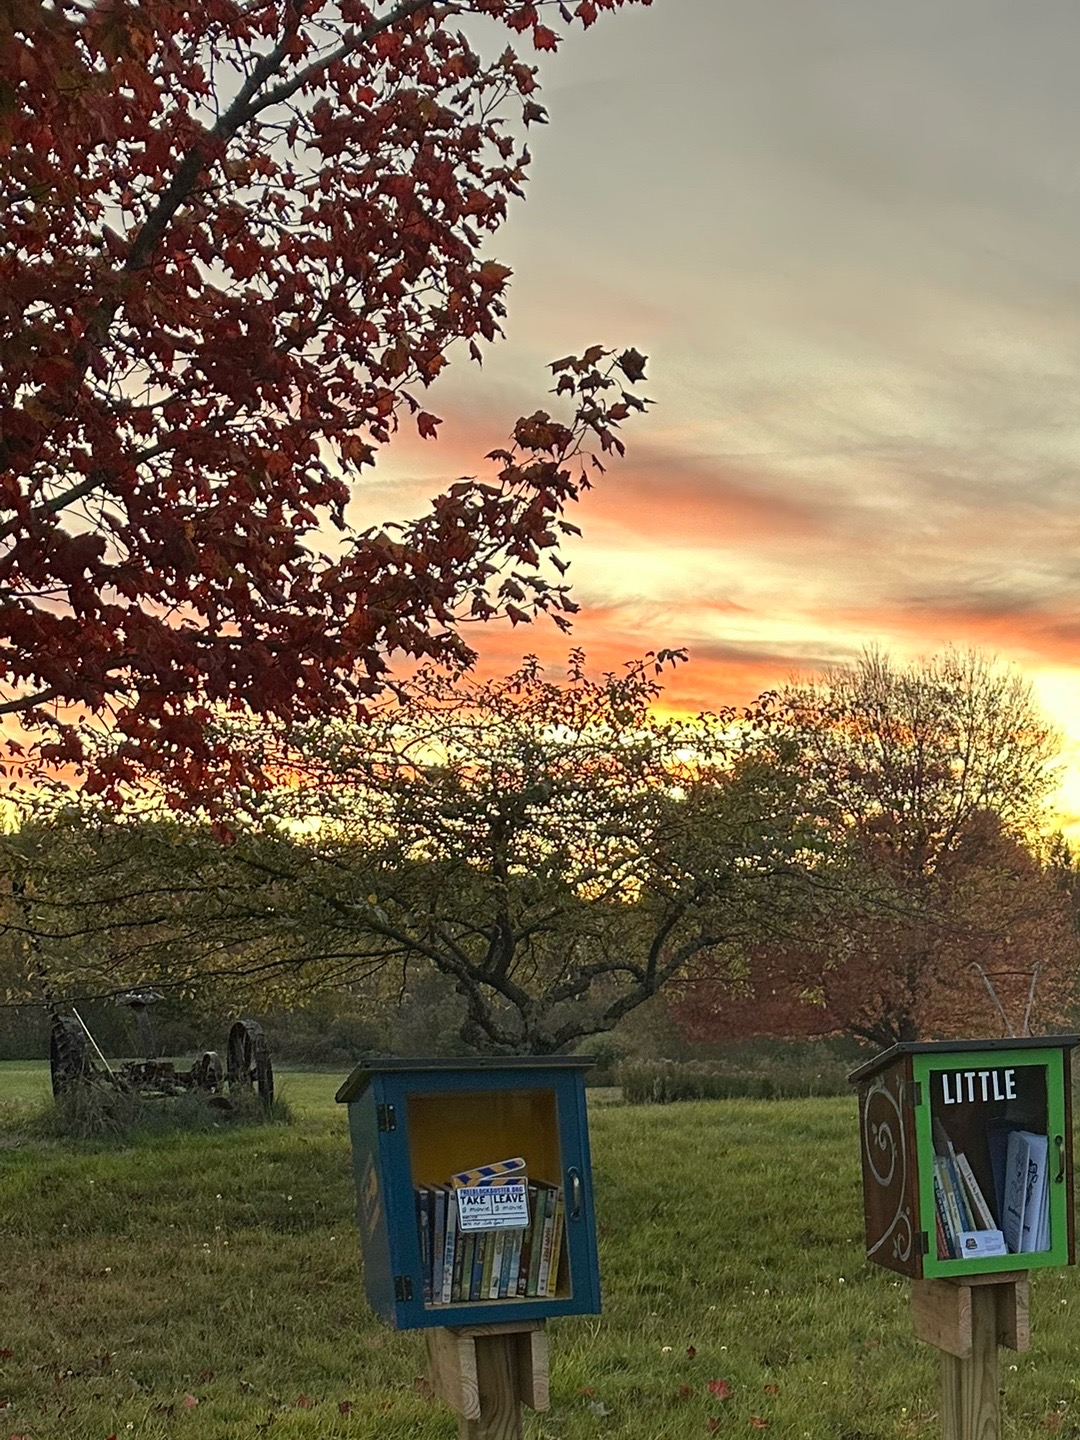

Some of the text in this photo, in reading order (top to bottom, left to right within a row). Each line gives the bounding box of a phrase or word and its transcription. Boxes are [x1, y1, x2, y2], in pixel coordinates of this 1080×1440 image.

[942, 1069, 1017, 1105] LITTLE
[460, 1196, 486, 1205] TAKE
[494, 1194, 524, 1203] LEAVE
